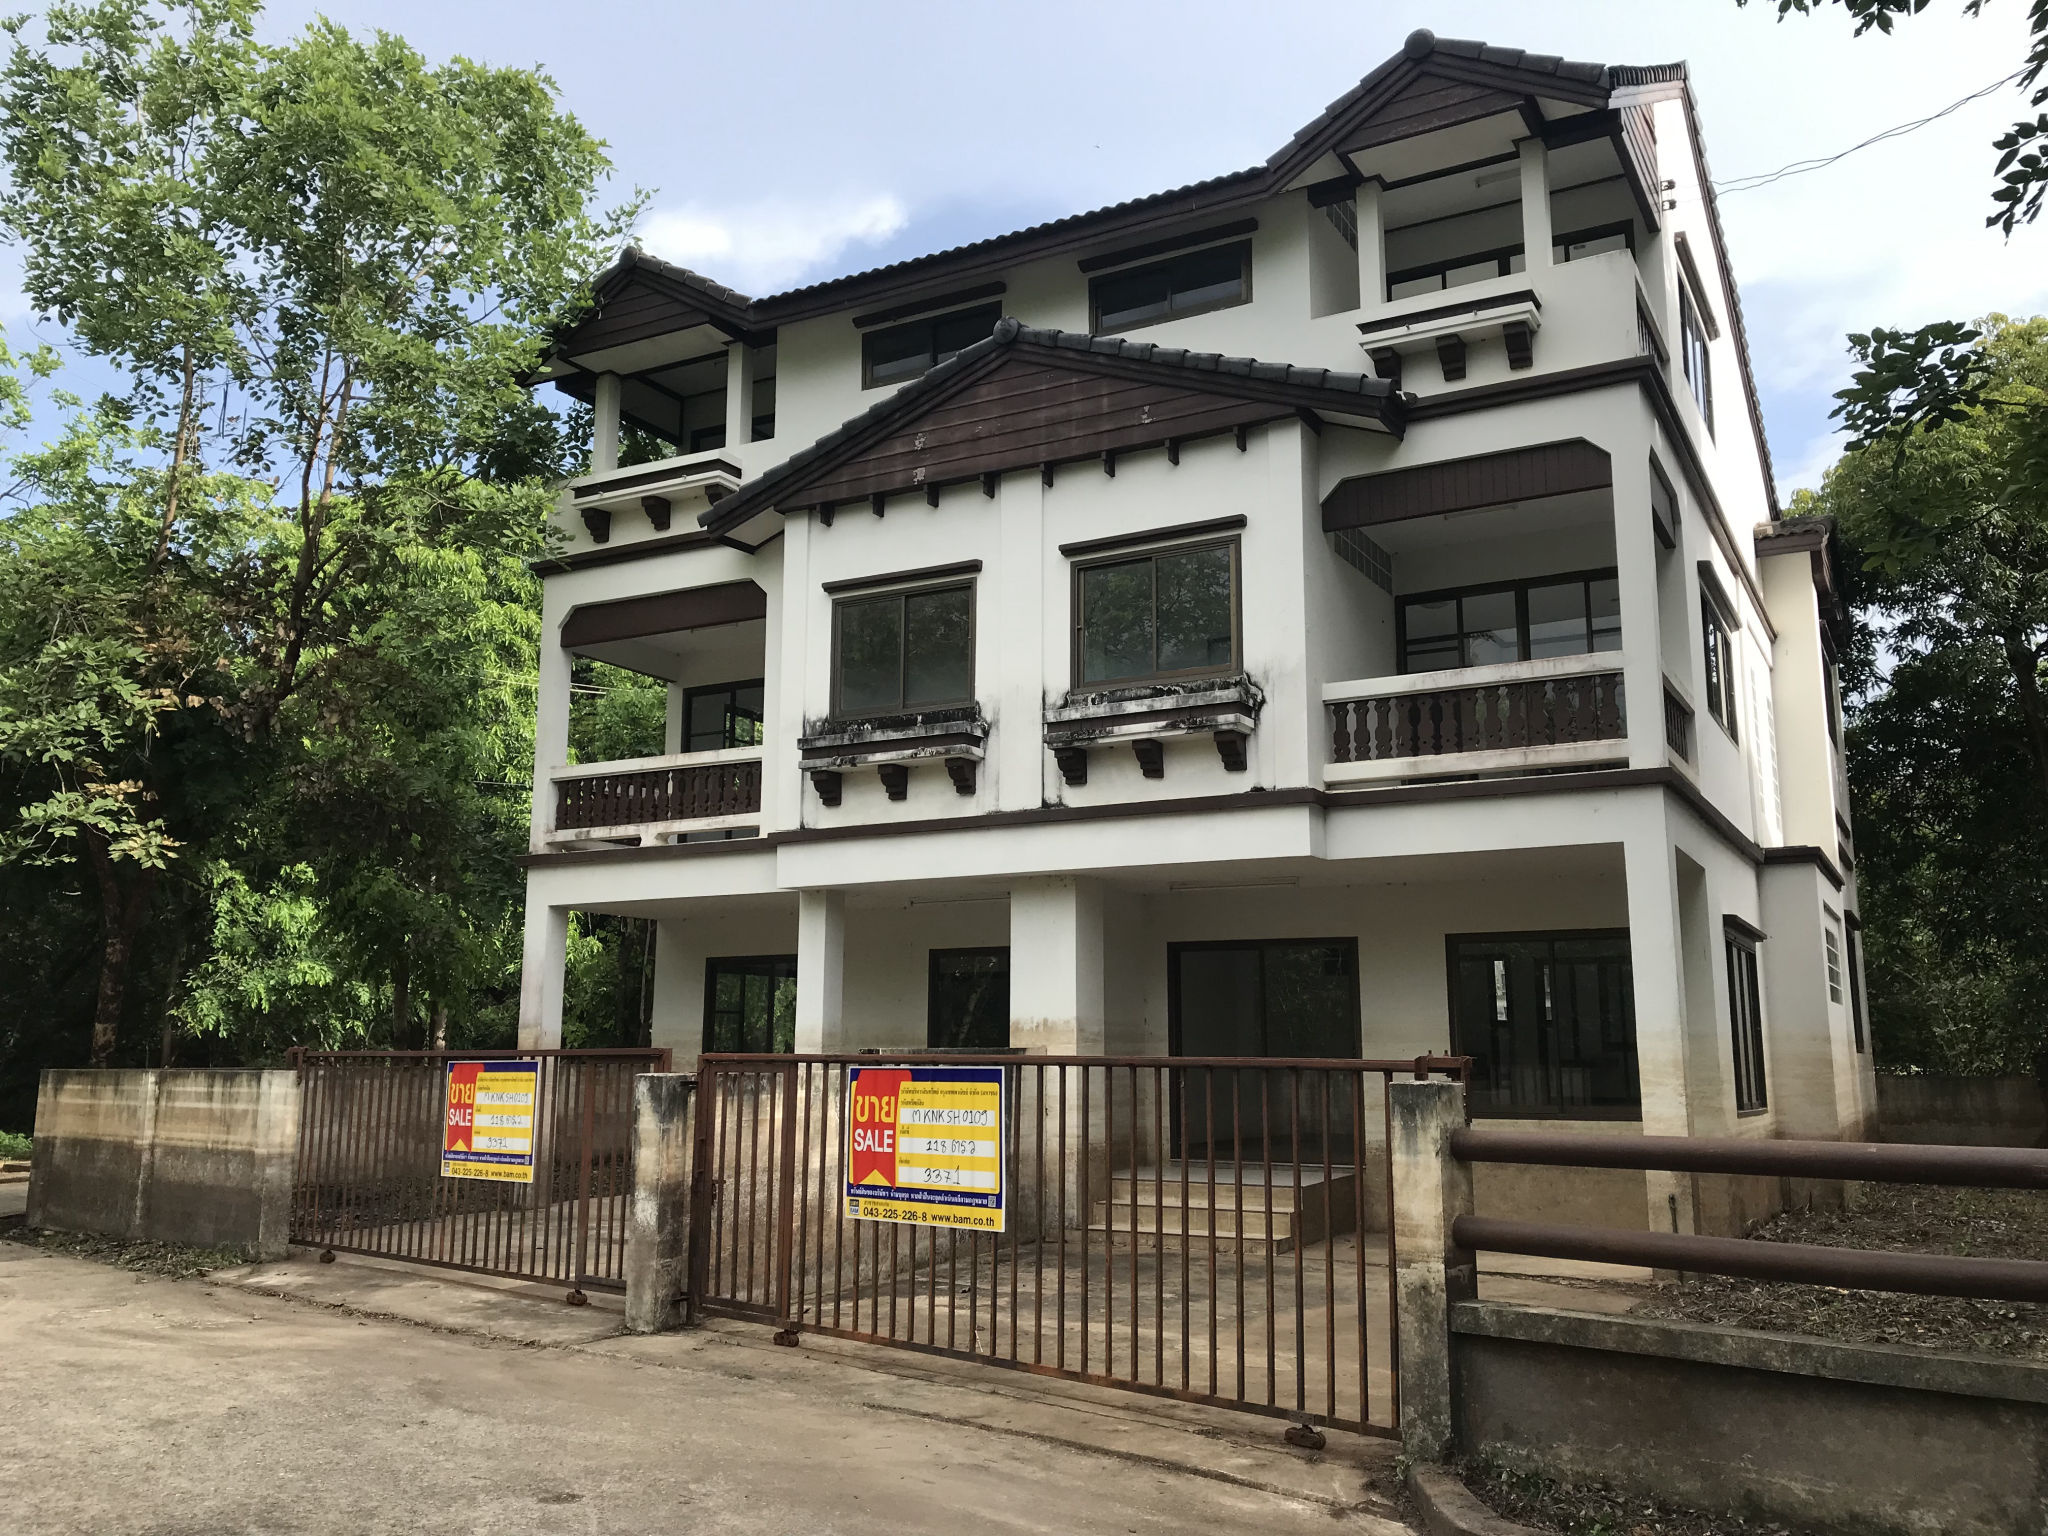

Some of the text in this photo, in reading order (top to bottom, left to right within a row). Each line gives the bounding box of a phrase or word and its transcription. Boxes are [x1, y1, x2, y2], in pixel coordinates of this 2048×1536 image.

[450, 1083, 474, 1104] ขาย
[448, 1108, 472, 1126] SALE
[856, 1095, 895, 1123] ขาย
[854, 1127, 894, 1153] SALE
[925, 1140, 947, 1153] 118
[490, 1170, 528, 1180] www.bam.co.th
[923, 1165, 961, 1185] 3371
[863, 1206, 995, 1227] 043-225-226-8 www.bam.co.th
